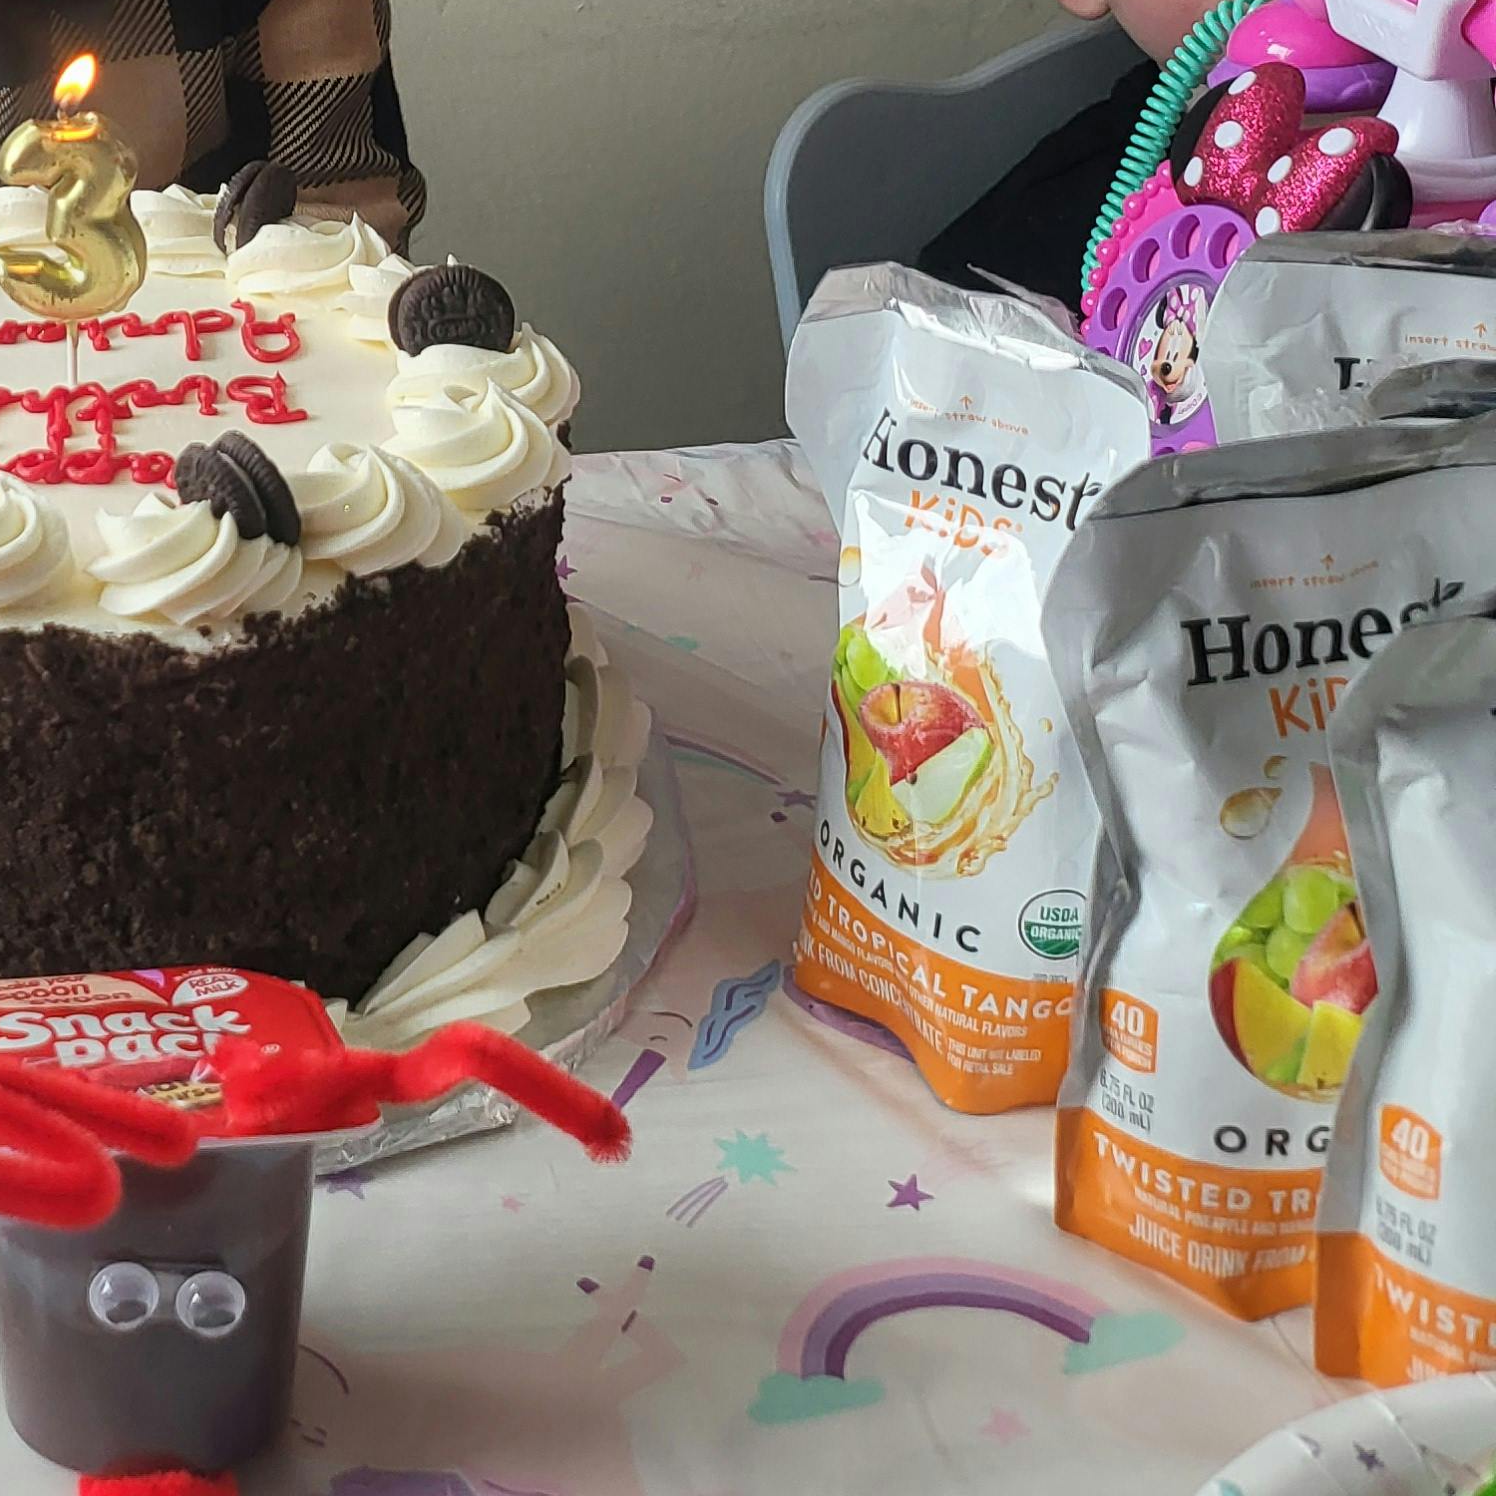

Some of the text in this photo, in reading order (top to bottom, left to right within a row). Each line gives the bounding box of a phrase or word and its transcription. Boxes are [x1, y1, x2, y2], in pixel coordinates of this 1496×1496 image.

[862, 406, 1104, 532] Honest
[819, 819, 982, 953] ORGANIC
[1040, 906, 1080, 923] USDA
[826, 894, 947, 999] TROPICAL
[960, 984, 1076, 1020] TANGO
[934, 1000, 980, 1034] NATURAL
[1110, 999, 1145, 1039] 40
[1092, 1129, 1251, 1211] TWISTED
[1391, 1118, 1431, 1161] 40
[1129, 1213, 1182, 1261] JUICE
[1188, 1240, 1249, 1279] DRINK
